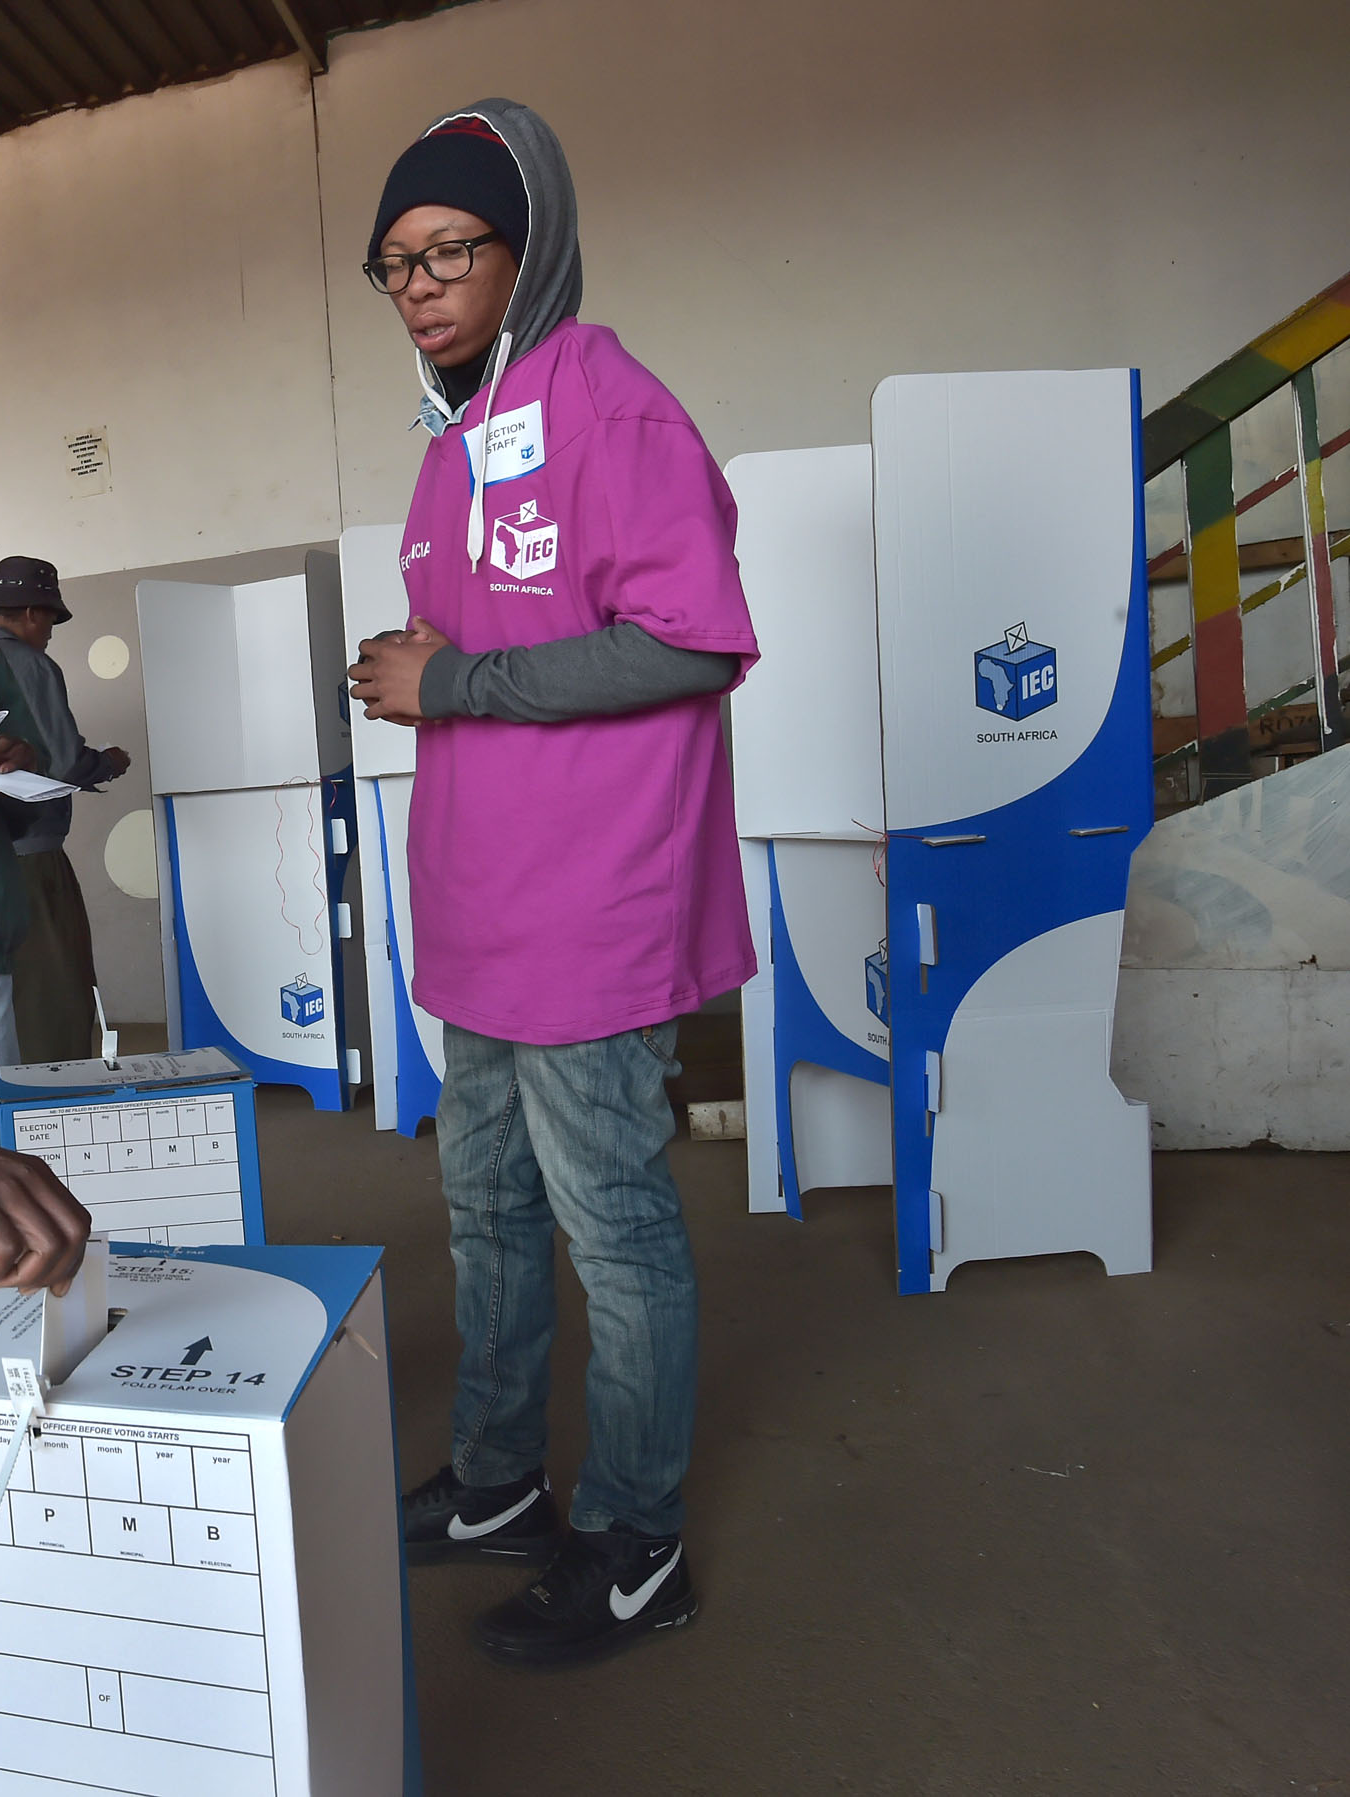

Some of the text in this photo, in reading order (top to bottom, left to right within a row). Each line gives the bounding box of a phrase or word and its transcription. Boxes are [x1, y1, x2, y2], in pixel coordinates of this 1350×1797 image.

[486, 421, 525, 443] ECTION
[487, 437, 517, 454] STAFF
[400, 541, 430, 572] EC ICIA
[526, 538, 554, 563] IEC
[490, 584, 554, 596] SOUTH AFRICA
[1022, 664, 1054, 700] IEC
[976, 730, 1058, 743] SOUTH AFRICA
[306, 998, 322, 1017] IEC
[868, 1032, 888, 1046] SOUTH
[20, 1123, 58, 1132] ELECTION
[84, 1152, 90, 1160] N
[127, 1148, 133, 1156] P
[212, 1141, 219, 1149] B
[110, 1365, 267, 1386] STEP 14
[121, 1381, 157, 1389] FOLD
[198, 1386, 237, 1394] OVER
[43, 1422, 77, 1432] OFFICER
[79, 1426, 112, 1435] BEFORE
[114, 1429, 145, 1438] VOTING
[148, 1431, 180, 1441] STARTS
[44, 1440, 69, 1449] month
[98, 1445, 123, 1454] month
[156, 1451, 174, 1459] year
[212, 1456, 230, 1464] year
[44, 1508, 55, 1522] P
[122, 1516, 137, 1532] M
[207, 1525, 220, 1540] B
[98, 1694, 111, 1702] OF
